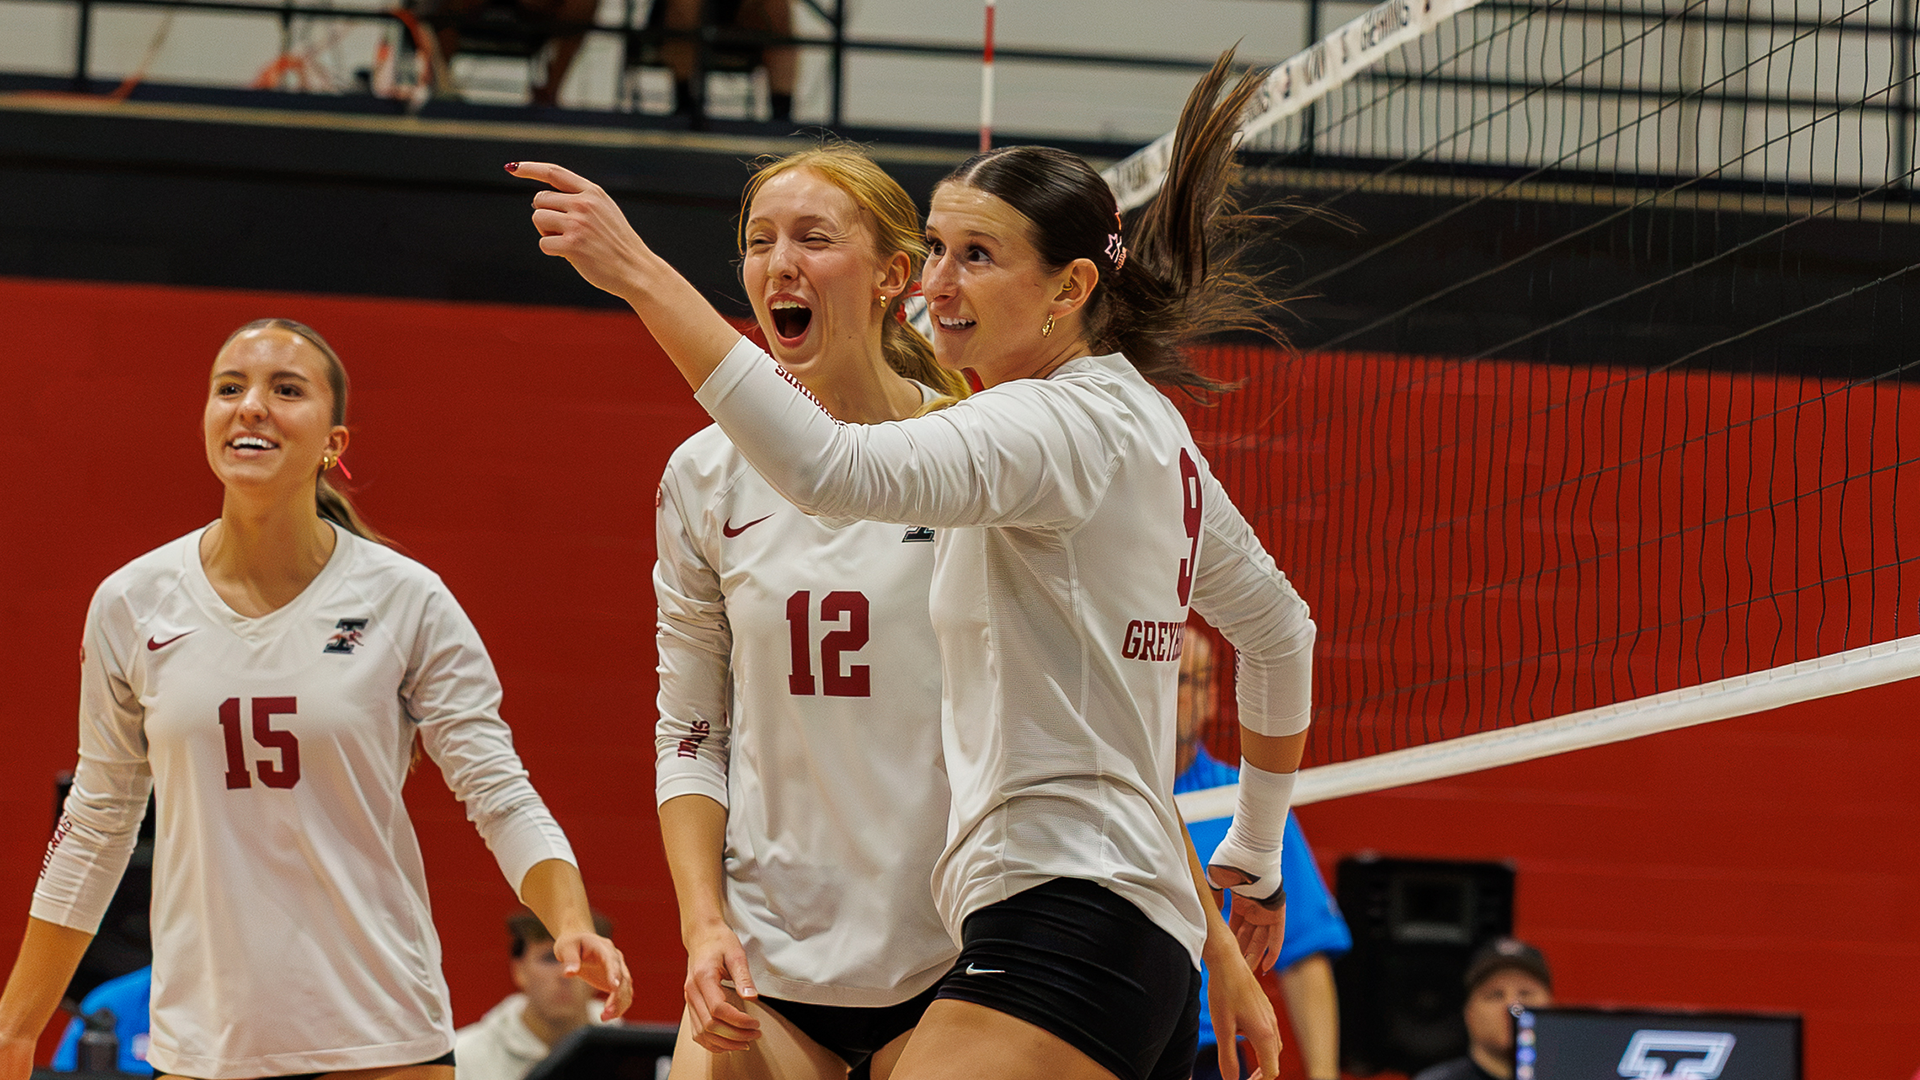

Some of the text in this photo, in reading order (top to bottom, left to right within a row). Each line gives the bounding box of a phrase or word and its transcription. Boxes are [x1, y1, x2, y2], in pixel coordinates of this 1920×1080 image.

[1177, 447, 1203, 607] 9
[786, 590, 871, 697] 12
[219, 696, 301, 790] 15
